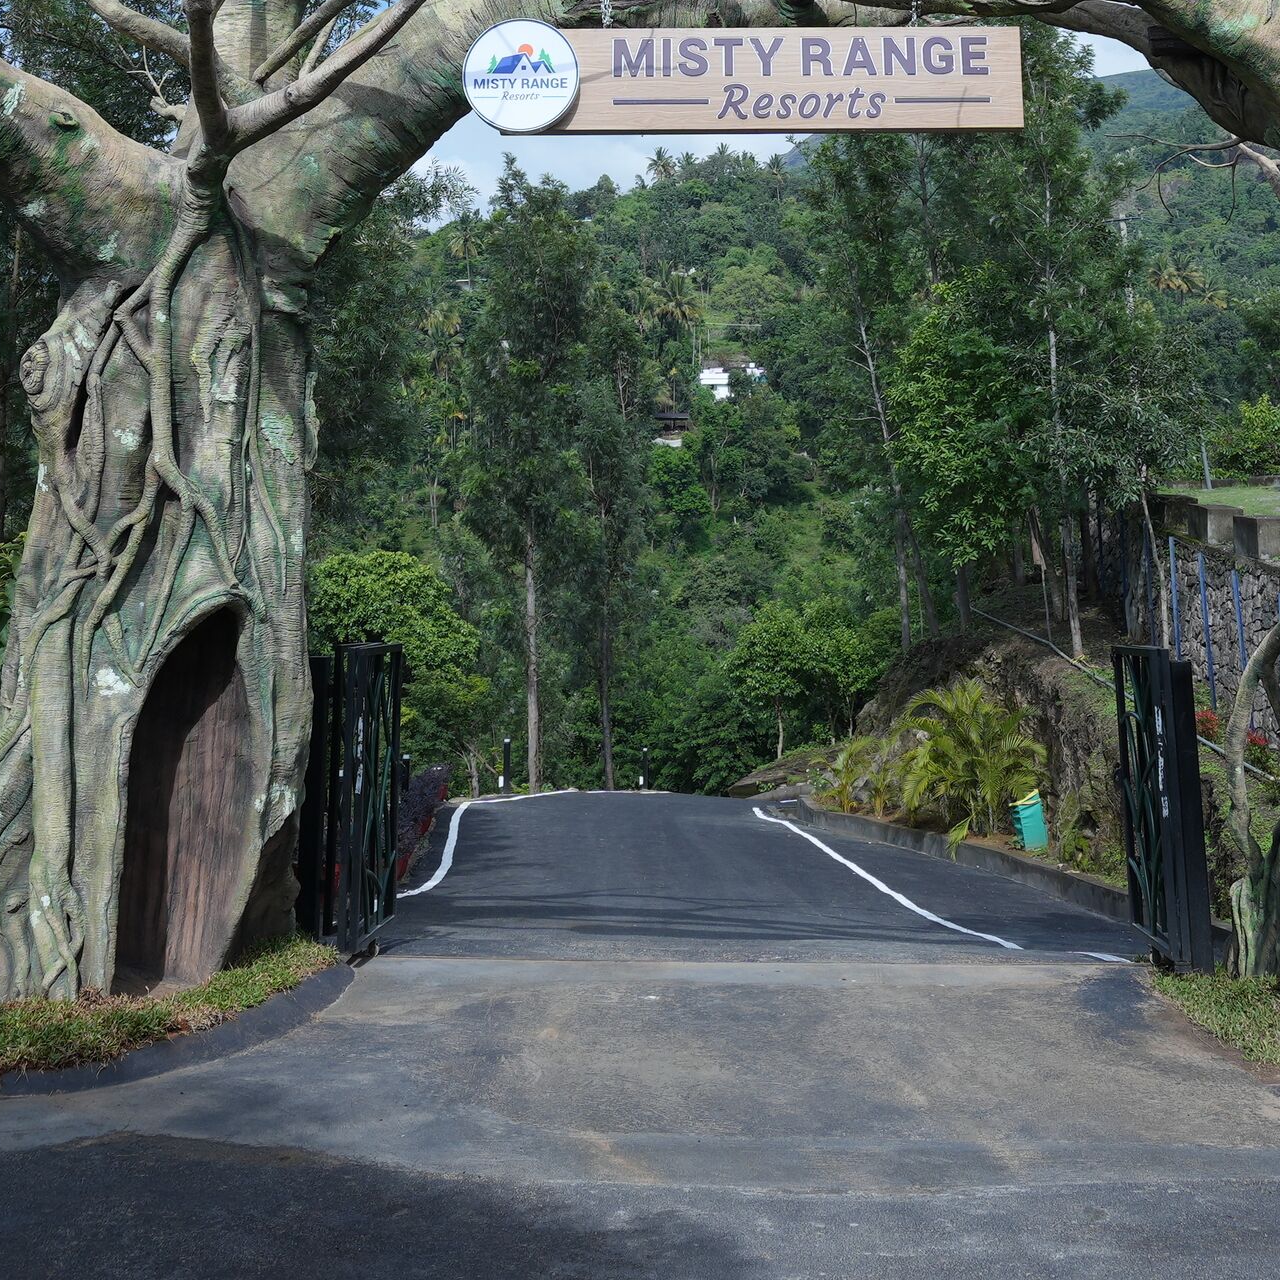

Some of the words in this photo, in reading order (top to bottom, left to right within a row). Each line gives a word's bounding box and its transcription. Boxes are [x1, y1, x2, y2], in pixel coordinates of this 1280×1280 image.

[613, 37, 784, 77] MISTY
[800, 36, 990, 77] RANGE
[473, 78, 517, 89] MISTY
[521, 78, 568, 89] RANGE
[501, 91, 540, 101] Resorts
[717, 83, 886, 120] Resorts
